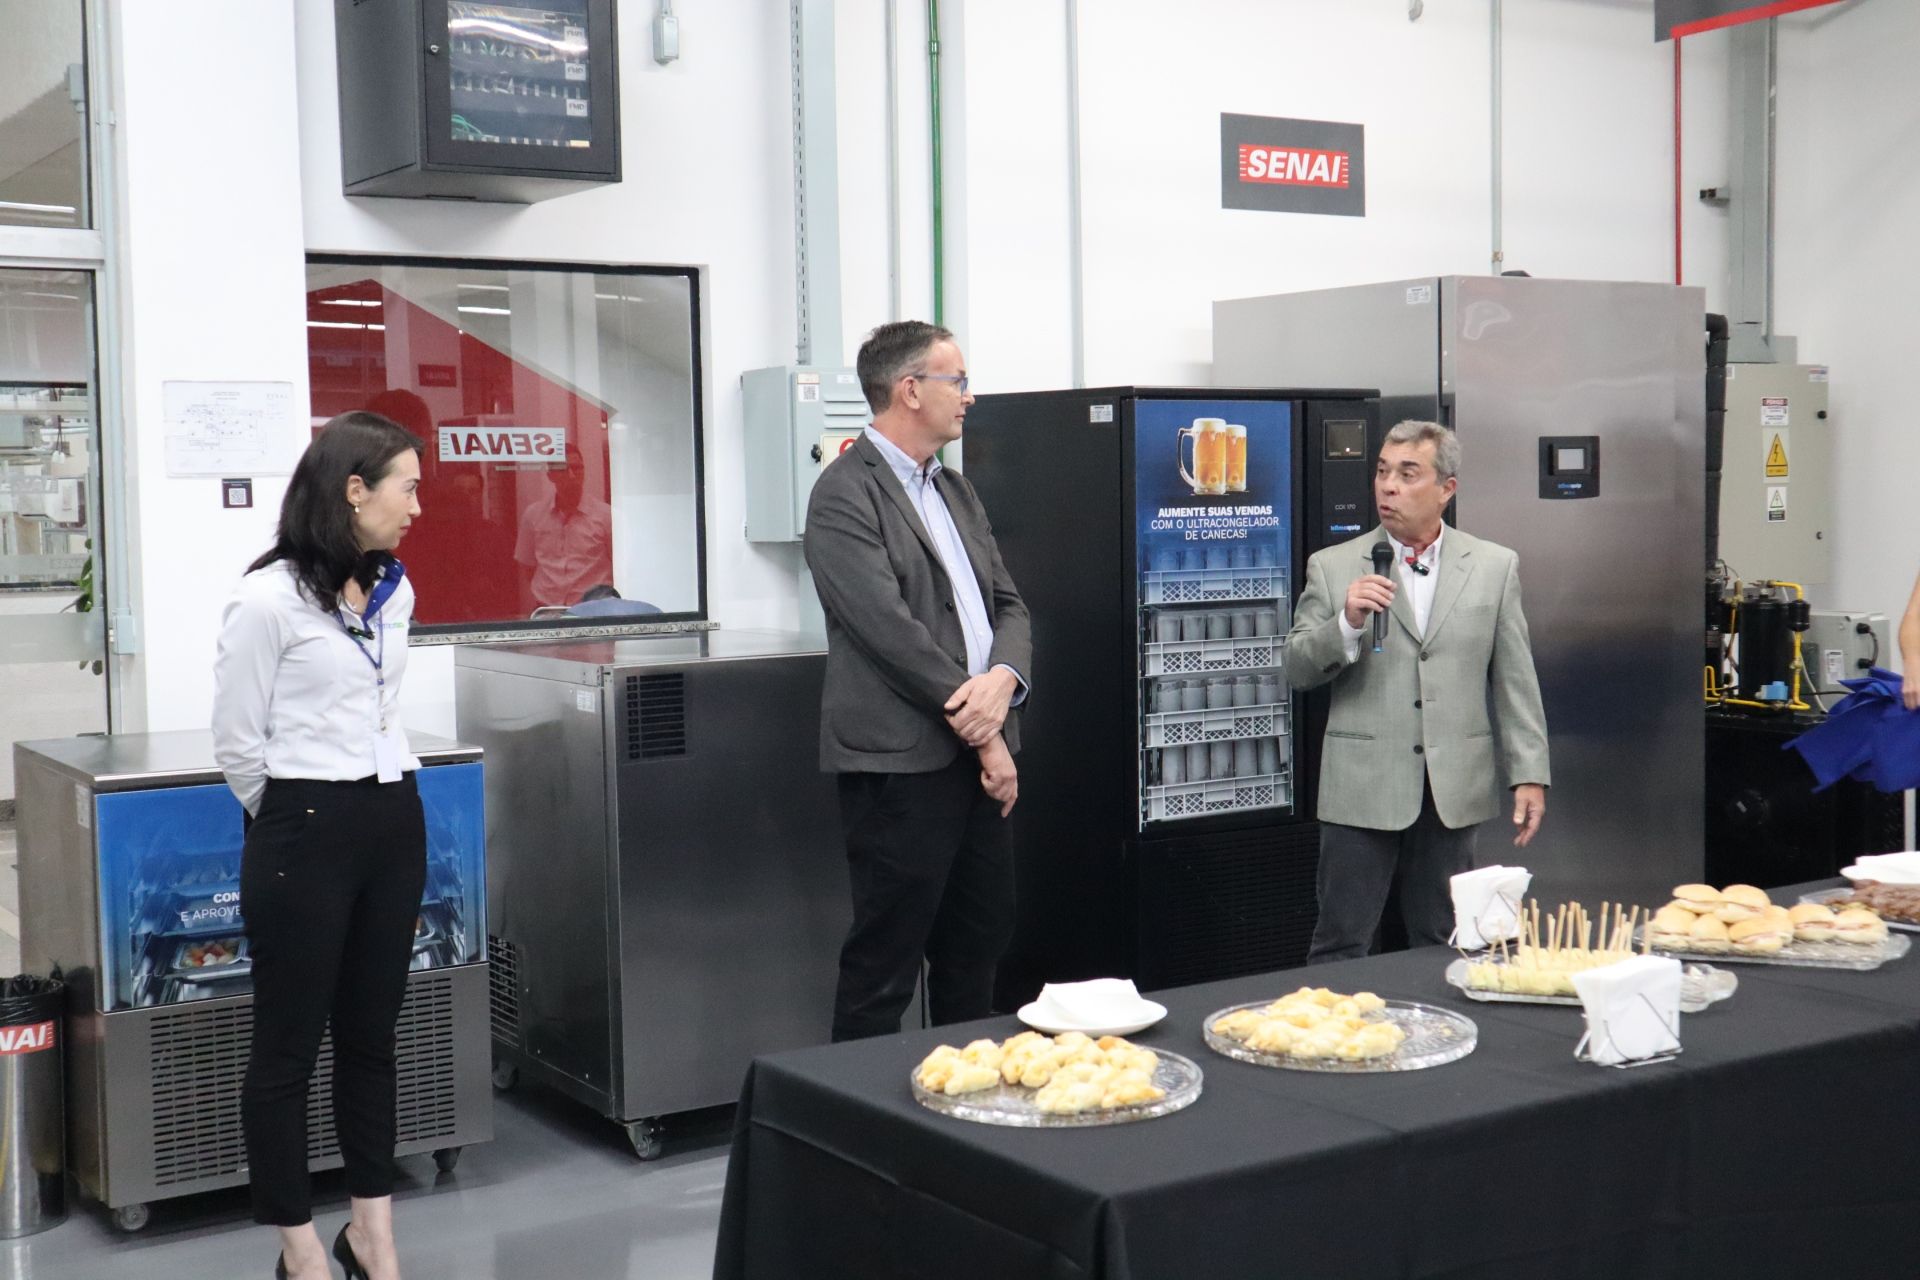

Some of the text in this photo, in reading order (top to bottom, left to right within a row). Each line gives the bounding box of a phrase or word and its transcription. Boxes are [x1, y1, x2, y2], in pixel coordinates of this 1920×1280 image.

[1247, 149, 1342, 183] SENAI
[1158, 505, 1273, 518] AUMENTE SUAS VENDAS
[1151, 516, 1280, 530] COM O ULTRACONGELADOR
[1185, 528, 1248, 540] DE CANECAS!
[180, 911, 189, 921] E
